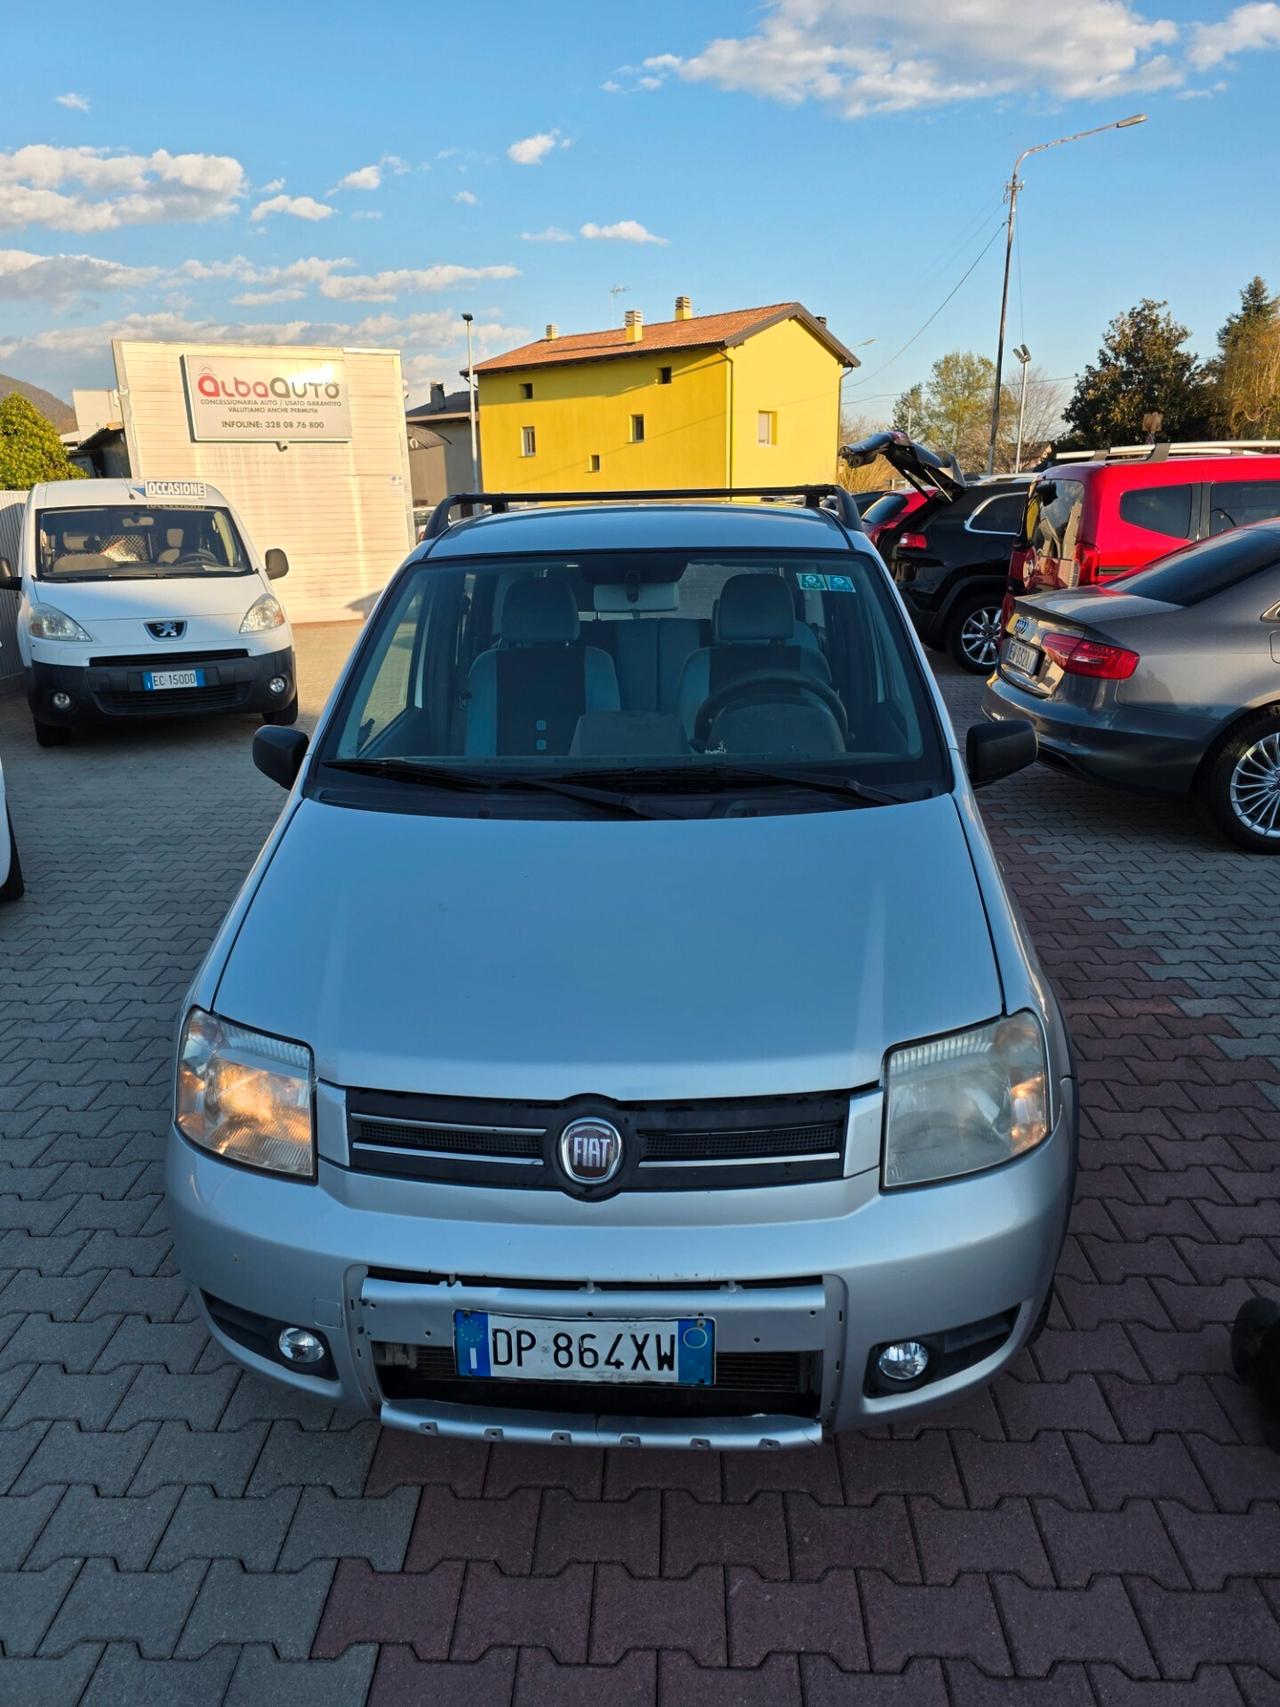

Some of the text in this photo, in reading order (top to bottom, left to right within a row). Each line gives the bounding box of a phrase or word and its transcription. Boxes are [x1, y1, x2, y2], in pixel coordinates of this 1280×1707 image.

[221, 420, 325, 429] INFOLINE: 328 08 76 800
[148, 481, 205, 497] OCCASIONE
[153, 675, 165, 687] EC
[573, 1136, 611, 1168] FIAT
[491, 1327, 537, 1368] DP
[553, 1331, 676, 1372] 864XW
